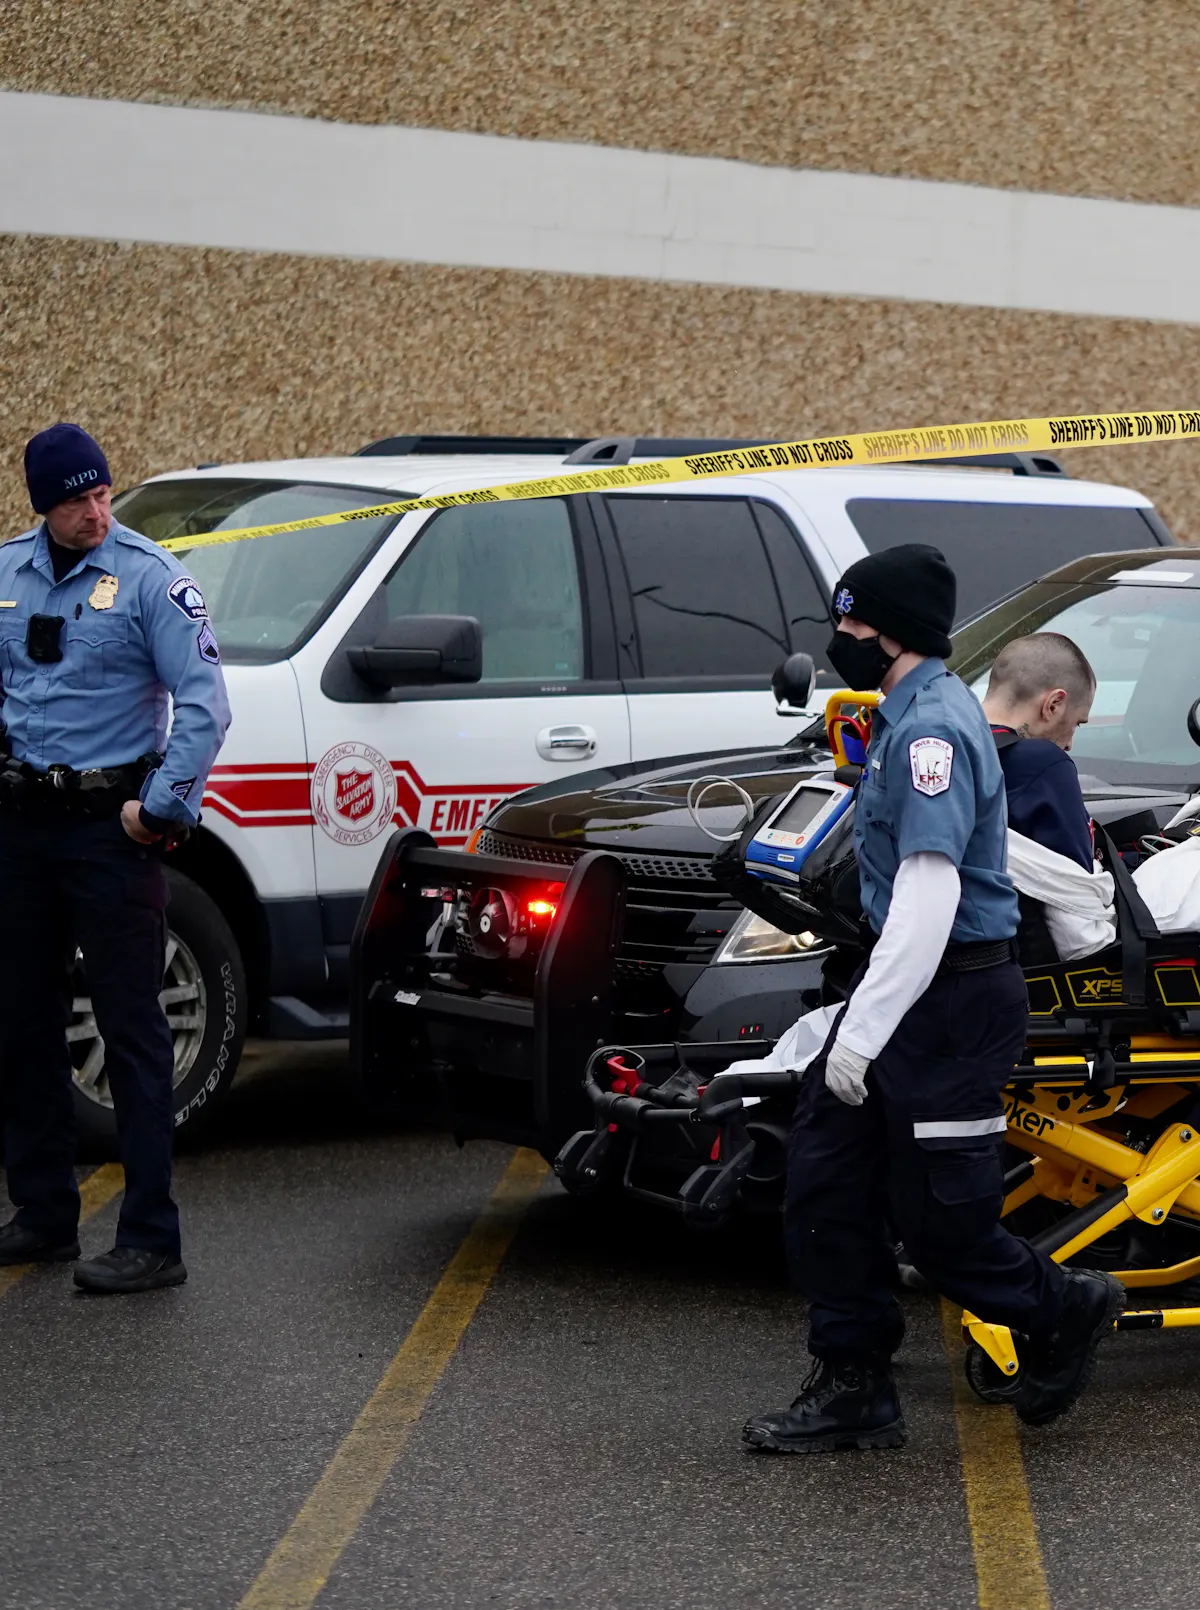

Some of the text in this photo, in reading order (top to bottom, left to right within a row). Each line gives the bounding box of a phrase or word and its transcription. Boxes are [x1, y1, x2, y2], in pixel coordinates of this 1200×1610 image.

[863, 423, 1029, 458] SHERIFF'S LINE DO NOT CROSS
[1049, 417, 1106, 444] SHERIFF'S
[1106, 416, 1134, 438] LINE
[1134, 415, 1153, 436] DO
[1155, 414, 1176, 435] NOT
[684, 440, 854, 475] SHERIFF'S LINE DO NOT CROSS
[64, 468, 98, 490] MPD
[506, 464, 670, 498] SHERIFF'S LINE DO NOT CROSS
[436, 496, 460, 508] NOT
[460, 490, 500, 504] CROSS
[316, 744, 394, 788] EMERGENCY DISASTER
[920, 775, 943, 786] EMS
[336, 776, 372, 810] SALVATION
[341, 772, 359, 792] THE
[349, 792, 372, 818] ARMY
[333, 828, 374, 844] SERVICES
[174, 962, 237, 1128] WRANGLE
